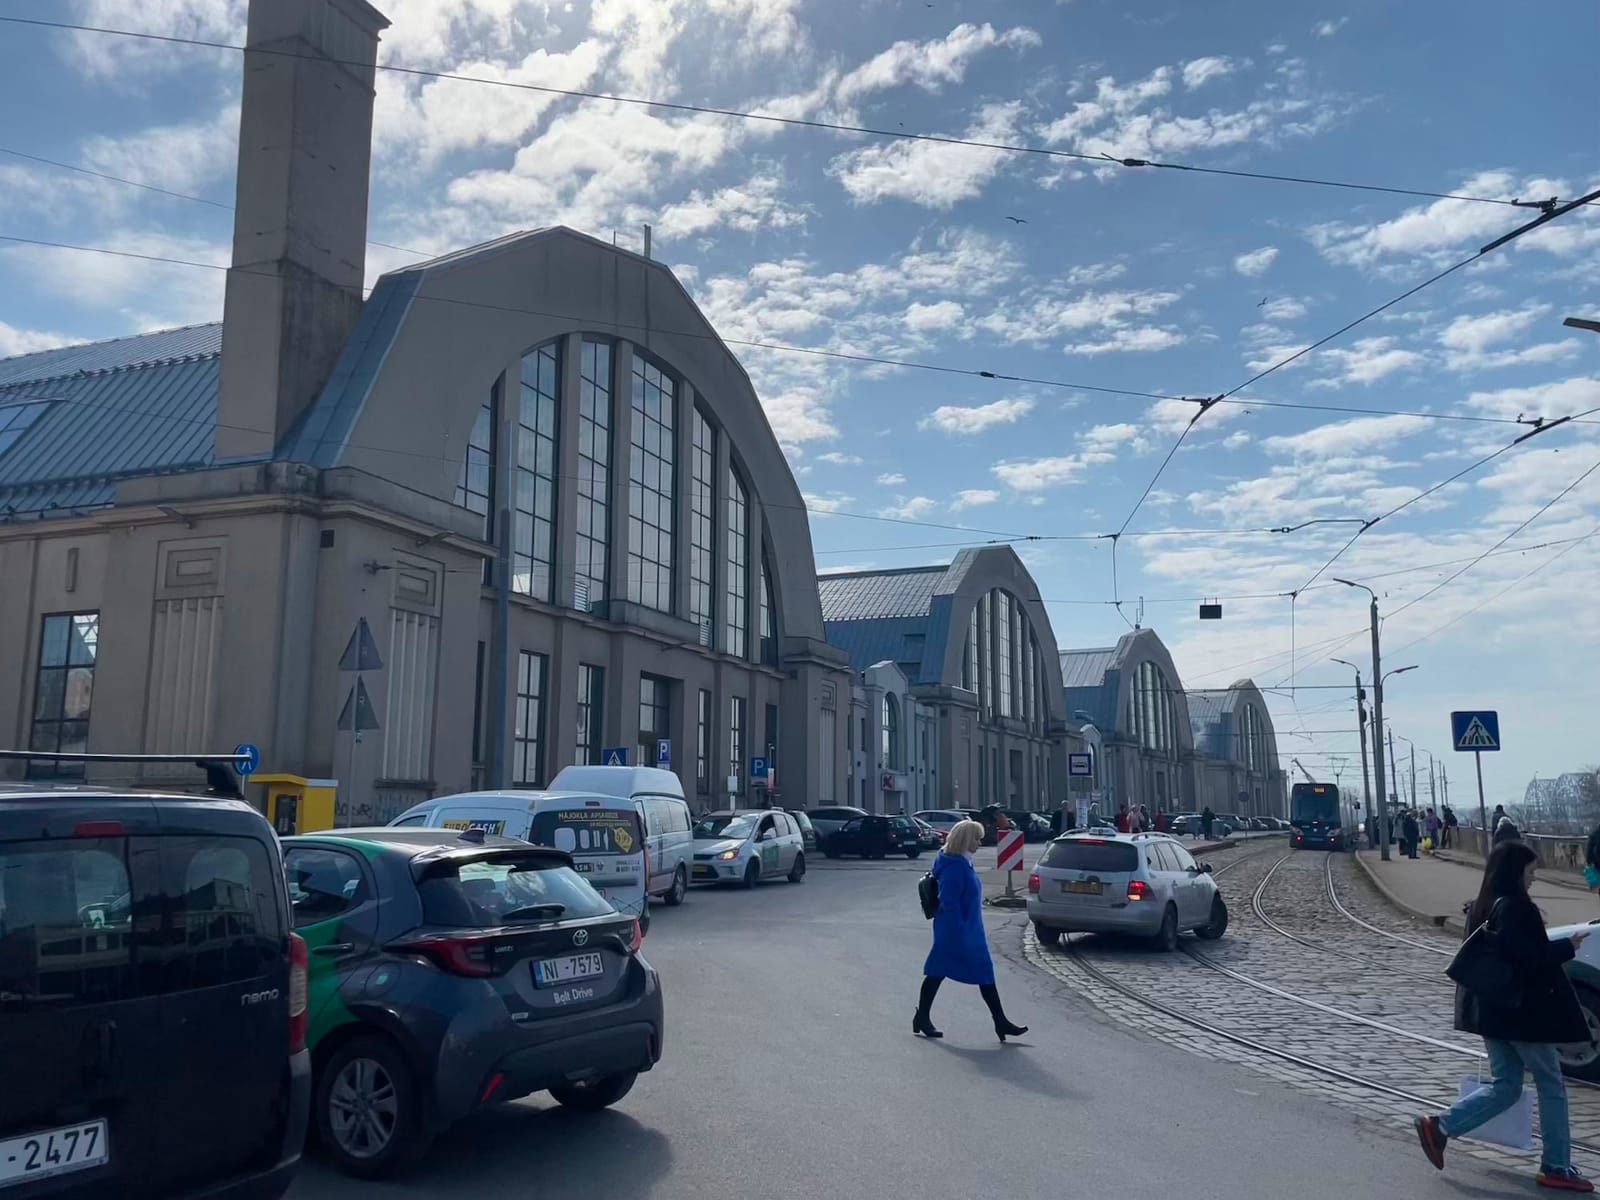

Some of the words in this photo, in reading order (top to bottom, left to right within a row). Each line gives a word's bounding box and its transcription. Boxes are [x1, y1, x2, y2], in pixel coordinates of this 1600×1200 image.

[659, 742, 668, 760] P
[754, 759, 764, 775] P
[544, 960, 559, 982] NI
[240, 988, 279, 1006] nemo
[553, 991, 571, 1005] Bolt
[571, 987, 594, 1001] Drive
[7, 1126, 100, 1171] -2477
